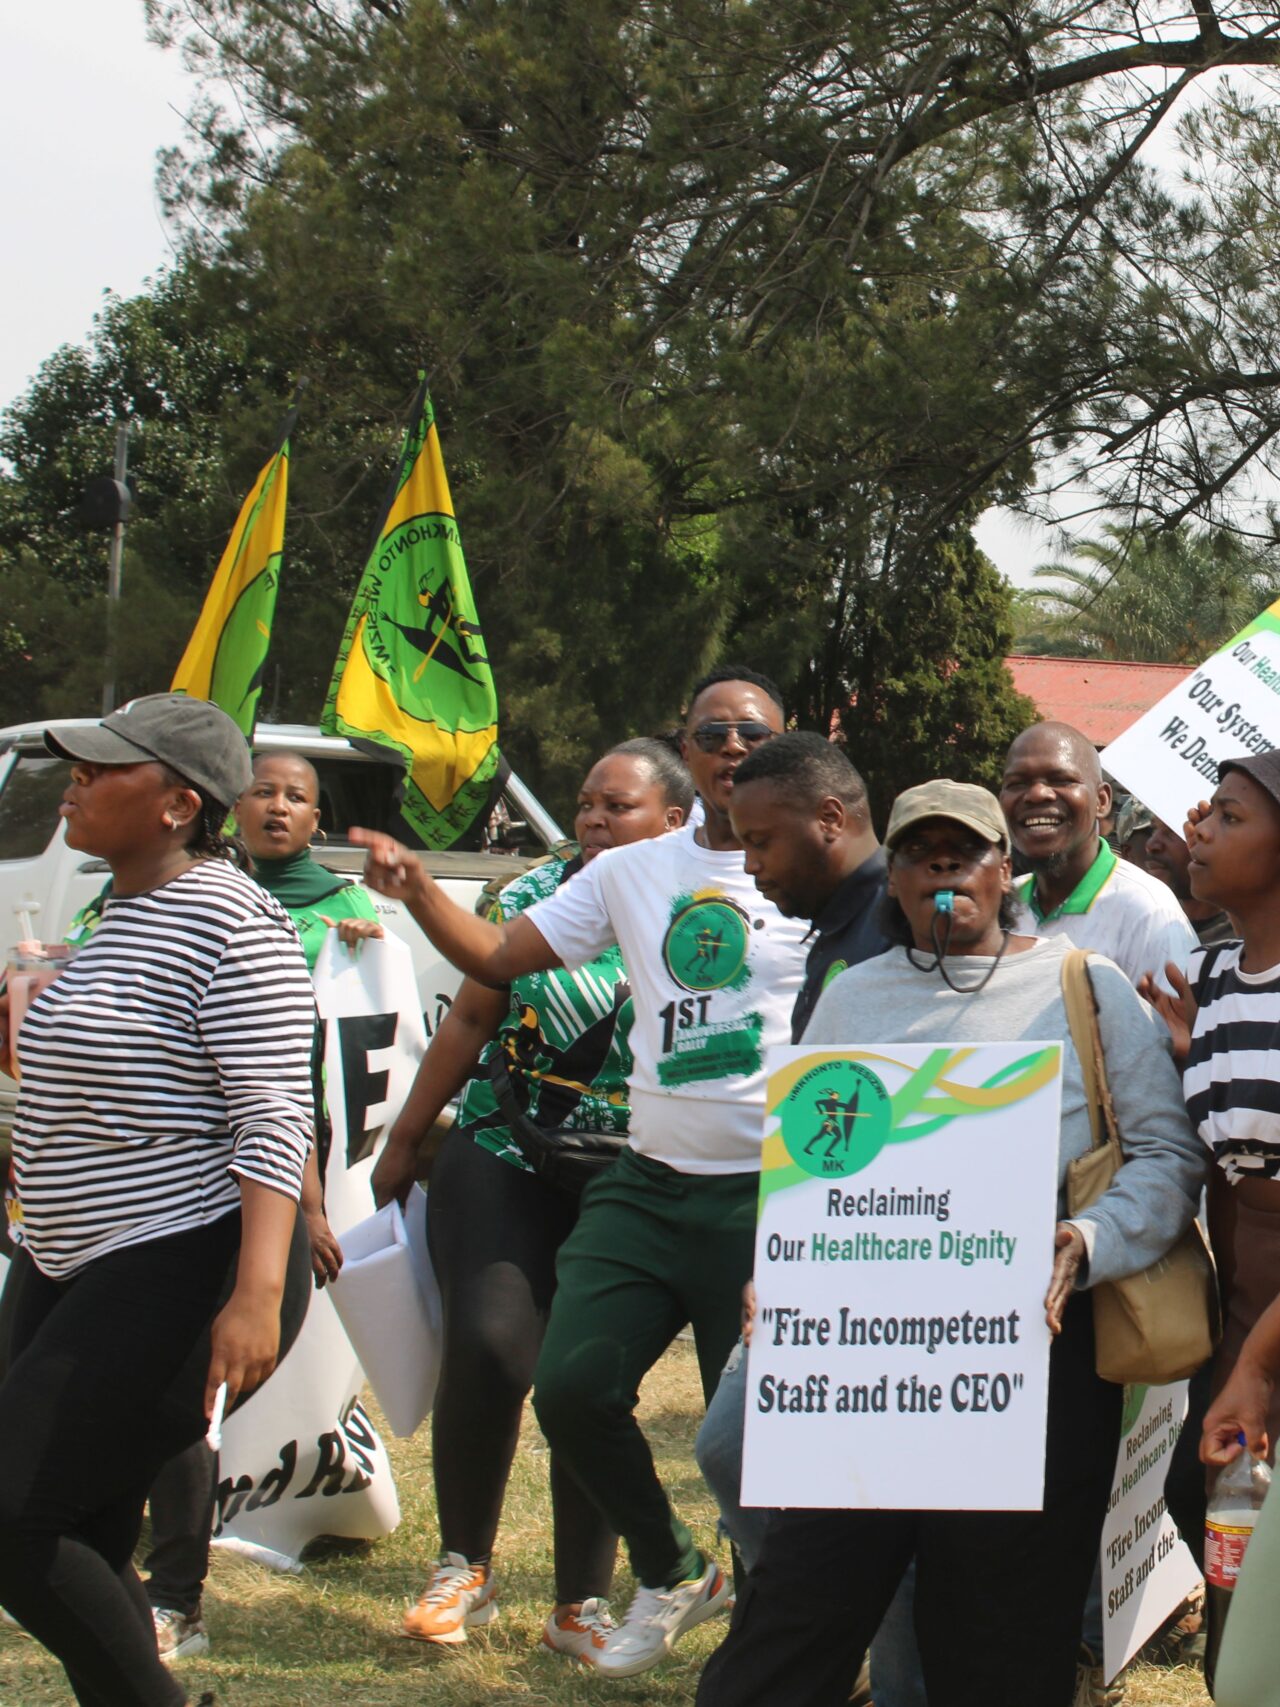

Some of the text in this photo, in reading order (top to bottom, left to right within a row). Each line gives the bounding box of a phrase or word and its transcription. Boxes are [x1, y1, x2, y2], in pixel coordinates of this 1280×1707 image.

[1231, 641, 1257, 666] Our
[1158, 715, 1221, 786] We Dema
[659, 995, 711, 1053] 1ST
[822, 1160, 845, 1172] MK
[827, 1187, 950, 1221] Reclaiming
[767, 1230, 1017, 1266] Our Healthcare Dignity
[762, 1307, 1020, 1354] "Fire Incompetent
[758, 1373, 1024, 1413] Staff and the CEO"
[1126, 1398, 1173, 1461] Reclaiming
[1121, 1440, 1167, 1497] Healthcare
[1106, 1496, 1167, 1569] "Fire Incom
[1108, 1530, 1174, 1619] Staff and the
